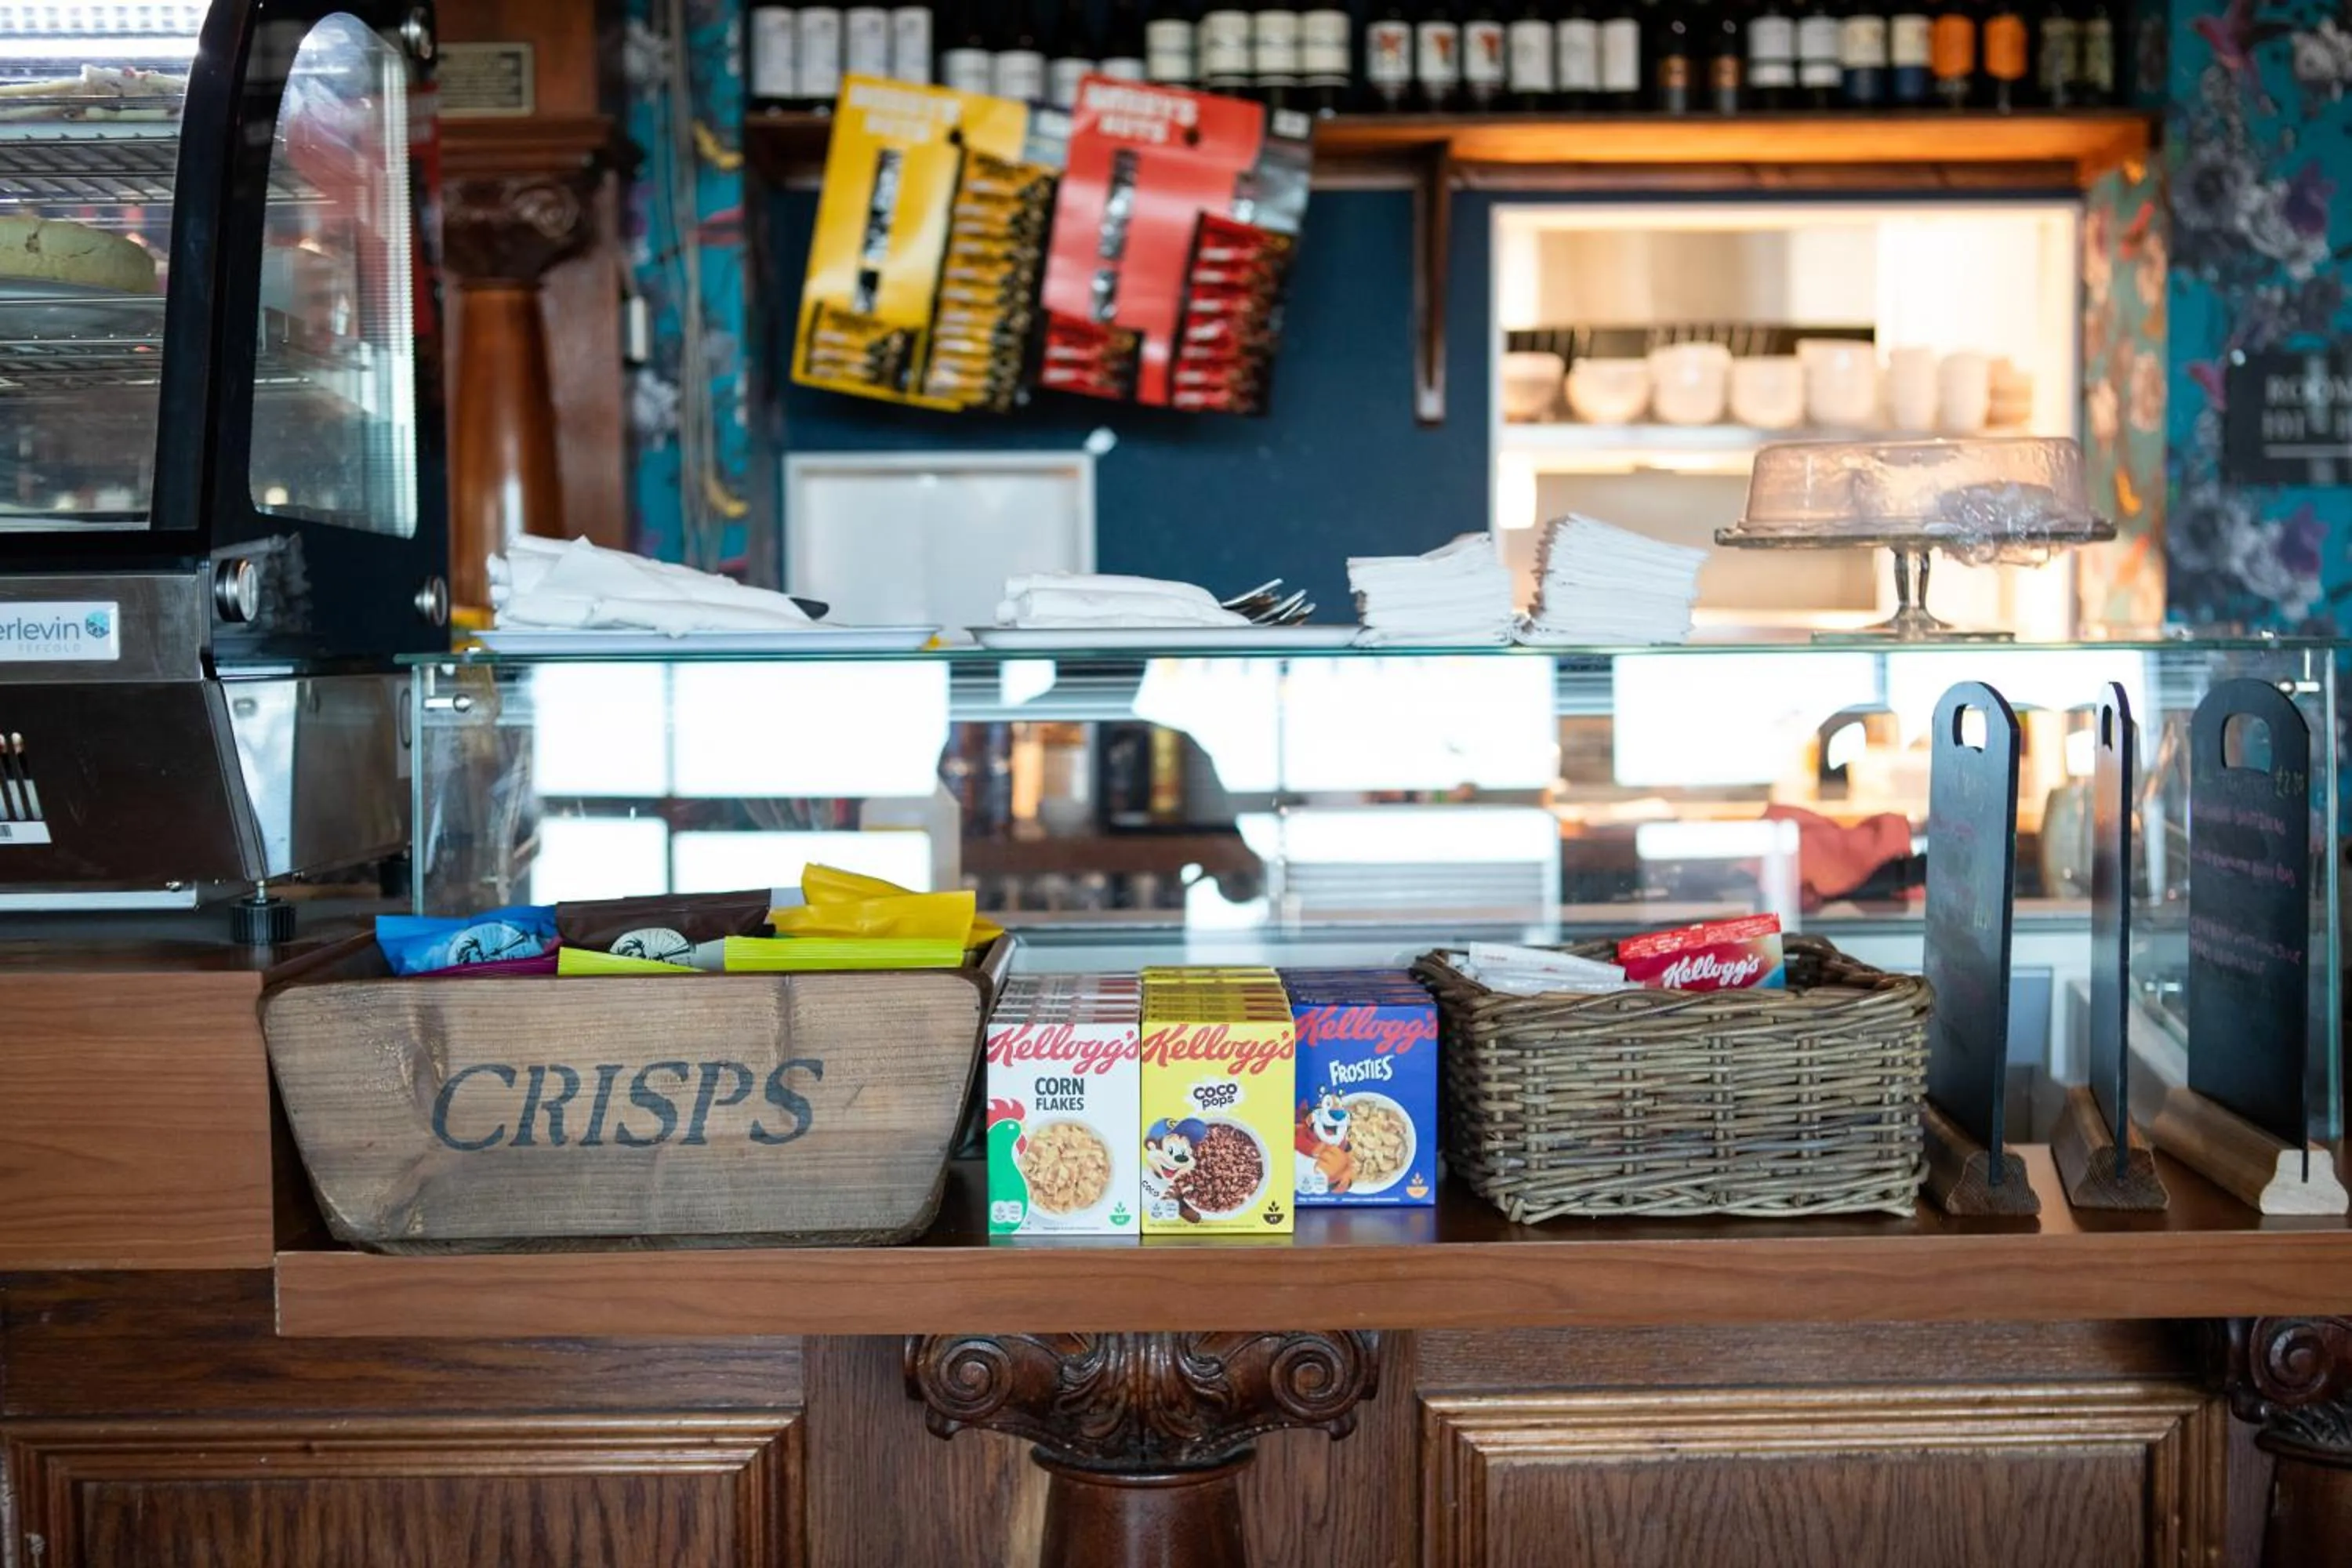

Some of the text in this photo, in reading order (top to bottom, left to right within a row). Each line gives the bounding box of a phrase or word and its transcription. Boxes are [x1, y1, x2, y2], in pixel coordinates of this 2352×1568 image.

[1662, 953, 1760, 989] Kellogg's
[1296, 1003, 1438, 1054] Kellogg's
[988, 1021, 1140, 1075] Kellogg's
[1142, 1023, 1294, 1075] Kellogg's
[1035, 1077, 1084, 1095] CORN
[1329, 1054, 1394, 1087] FROSTIES
[431, 1058, 824, 1151] CRISPS
[1036, 1098, 1084, 1111] FLAKES
[1202, 1095, 1235, 1110] pops
